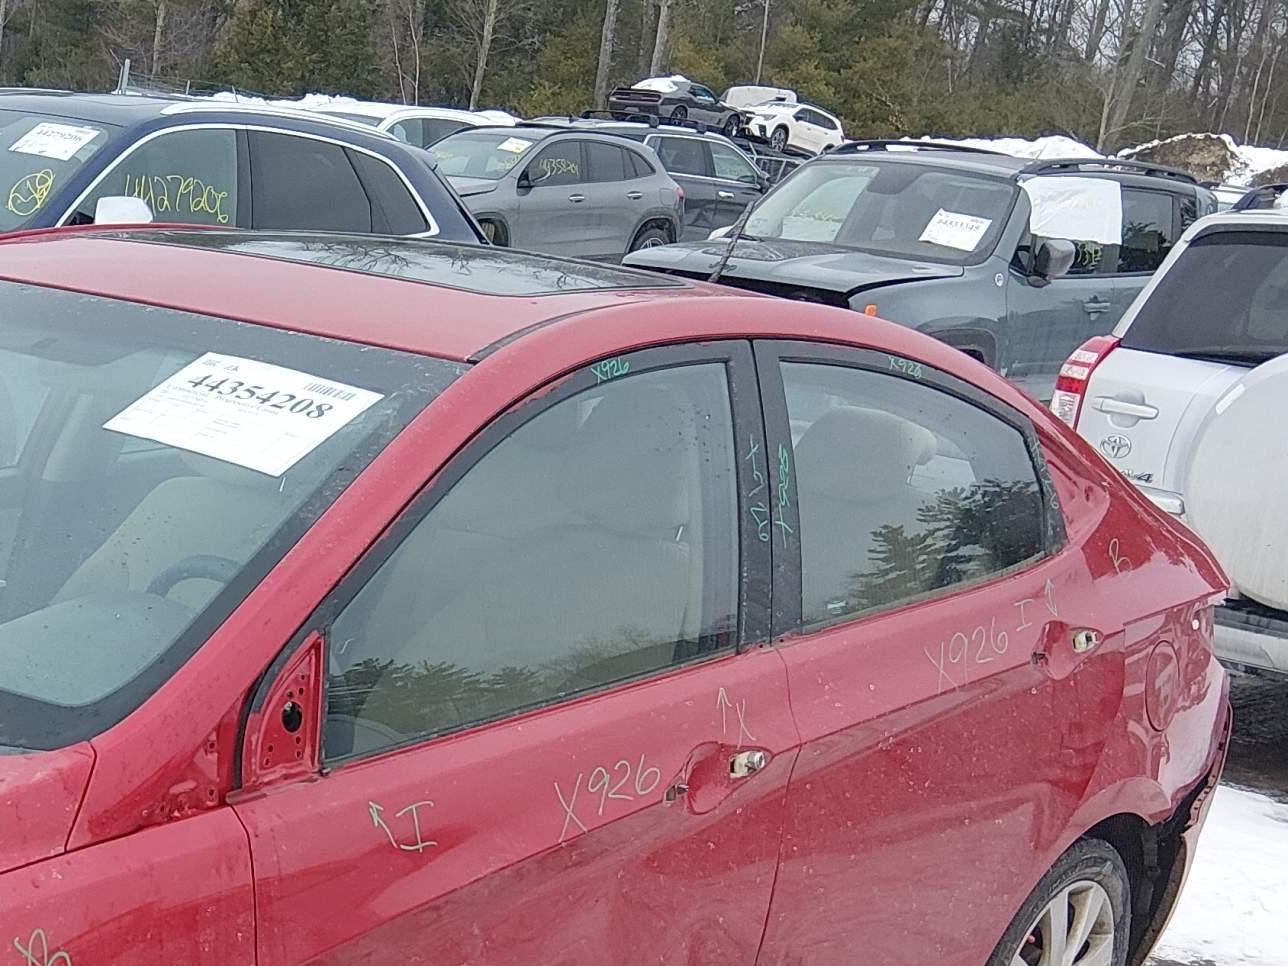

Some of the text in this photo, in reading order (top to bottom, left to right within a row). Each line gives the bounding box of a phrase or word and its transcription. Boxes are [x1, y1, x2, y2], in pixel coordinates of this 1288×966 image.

[188, 374, 334, 419] 44354208
[591, 358, 631, 384] X926
[924, 616, 1009, 694] X926
[553, 753, 661, 848] X926
